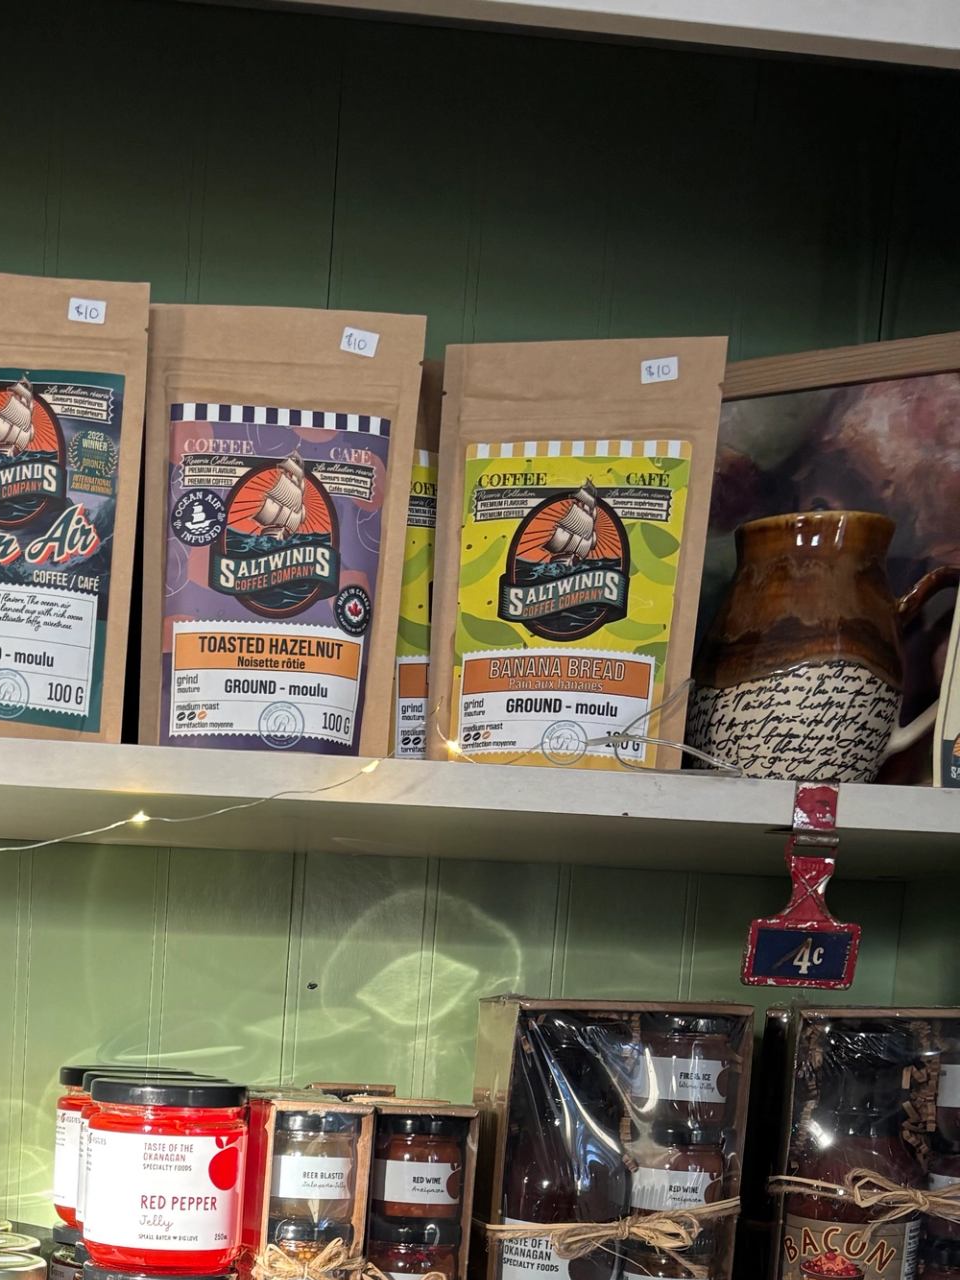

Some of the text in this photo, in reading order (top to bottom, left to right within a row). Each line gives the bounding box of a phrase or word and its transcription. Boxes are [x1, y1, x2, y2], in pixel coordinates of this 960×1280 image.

[87, 430, 104, 441] 2023
[184, 438, 254, 456] COFFEE
[330, 446, 372, 465] CAFÉ
[478, 472, 547, 488] COFFEE
[626, 470, 670, 487] CAFÉ
[1, 482, 42, 497] COMPANY
[175, 492, 202, 517] OCEAN
[25, 503, 100, 564] Air
[220, 547, 330, 589] SALTWINDS
[33, 569, 100, 592] COFFEE CAFÉ
[509, 571, 619, 617] SALTWINDS
[522, 589, 604, 617] COFFEE COMPANY
[198, 635, 343, 660] TOASTED HAZELNUT
[14, 651, 55, 668] moulu
[237, 656, 305, 670] Noisette rôtie
[489, 658, 625, 681] BANANA BREAD
[176, 674, 198, 686] grind
[224, 679, 328, 698] GROUND moulu
[47, 682, 84, 705] 100 G
[506, 698, 618, 718] GROUND moulu
[322, 711, 351, 734] 100 G
[144, 1142, 194, 1153] TASTE OF THE
[143, 1153, 186, 1162] OKANAGAN
[302, 1171, 344, 1180] BEER BLASTED
[412, 1176, 442, 1185] RED WINE
[140, 1195, 217, 1211] RED PEPPER
[139, 1214, 174, 1232] Jelly
[504, 1248, 551, 1261] OKANAGAN
[783, 1226, 896, 1274] BACON
[502, 1258, 560, 1272] SPECIALTY FOODS
